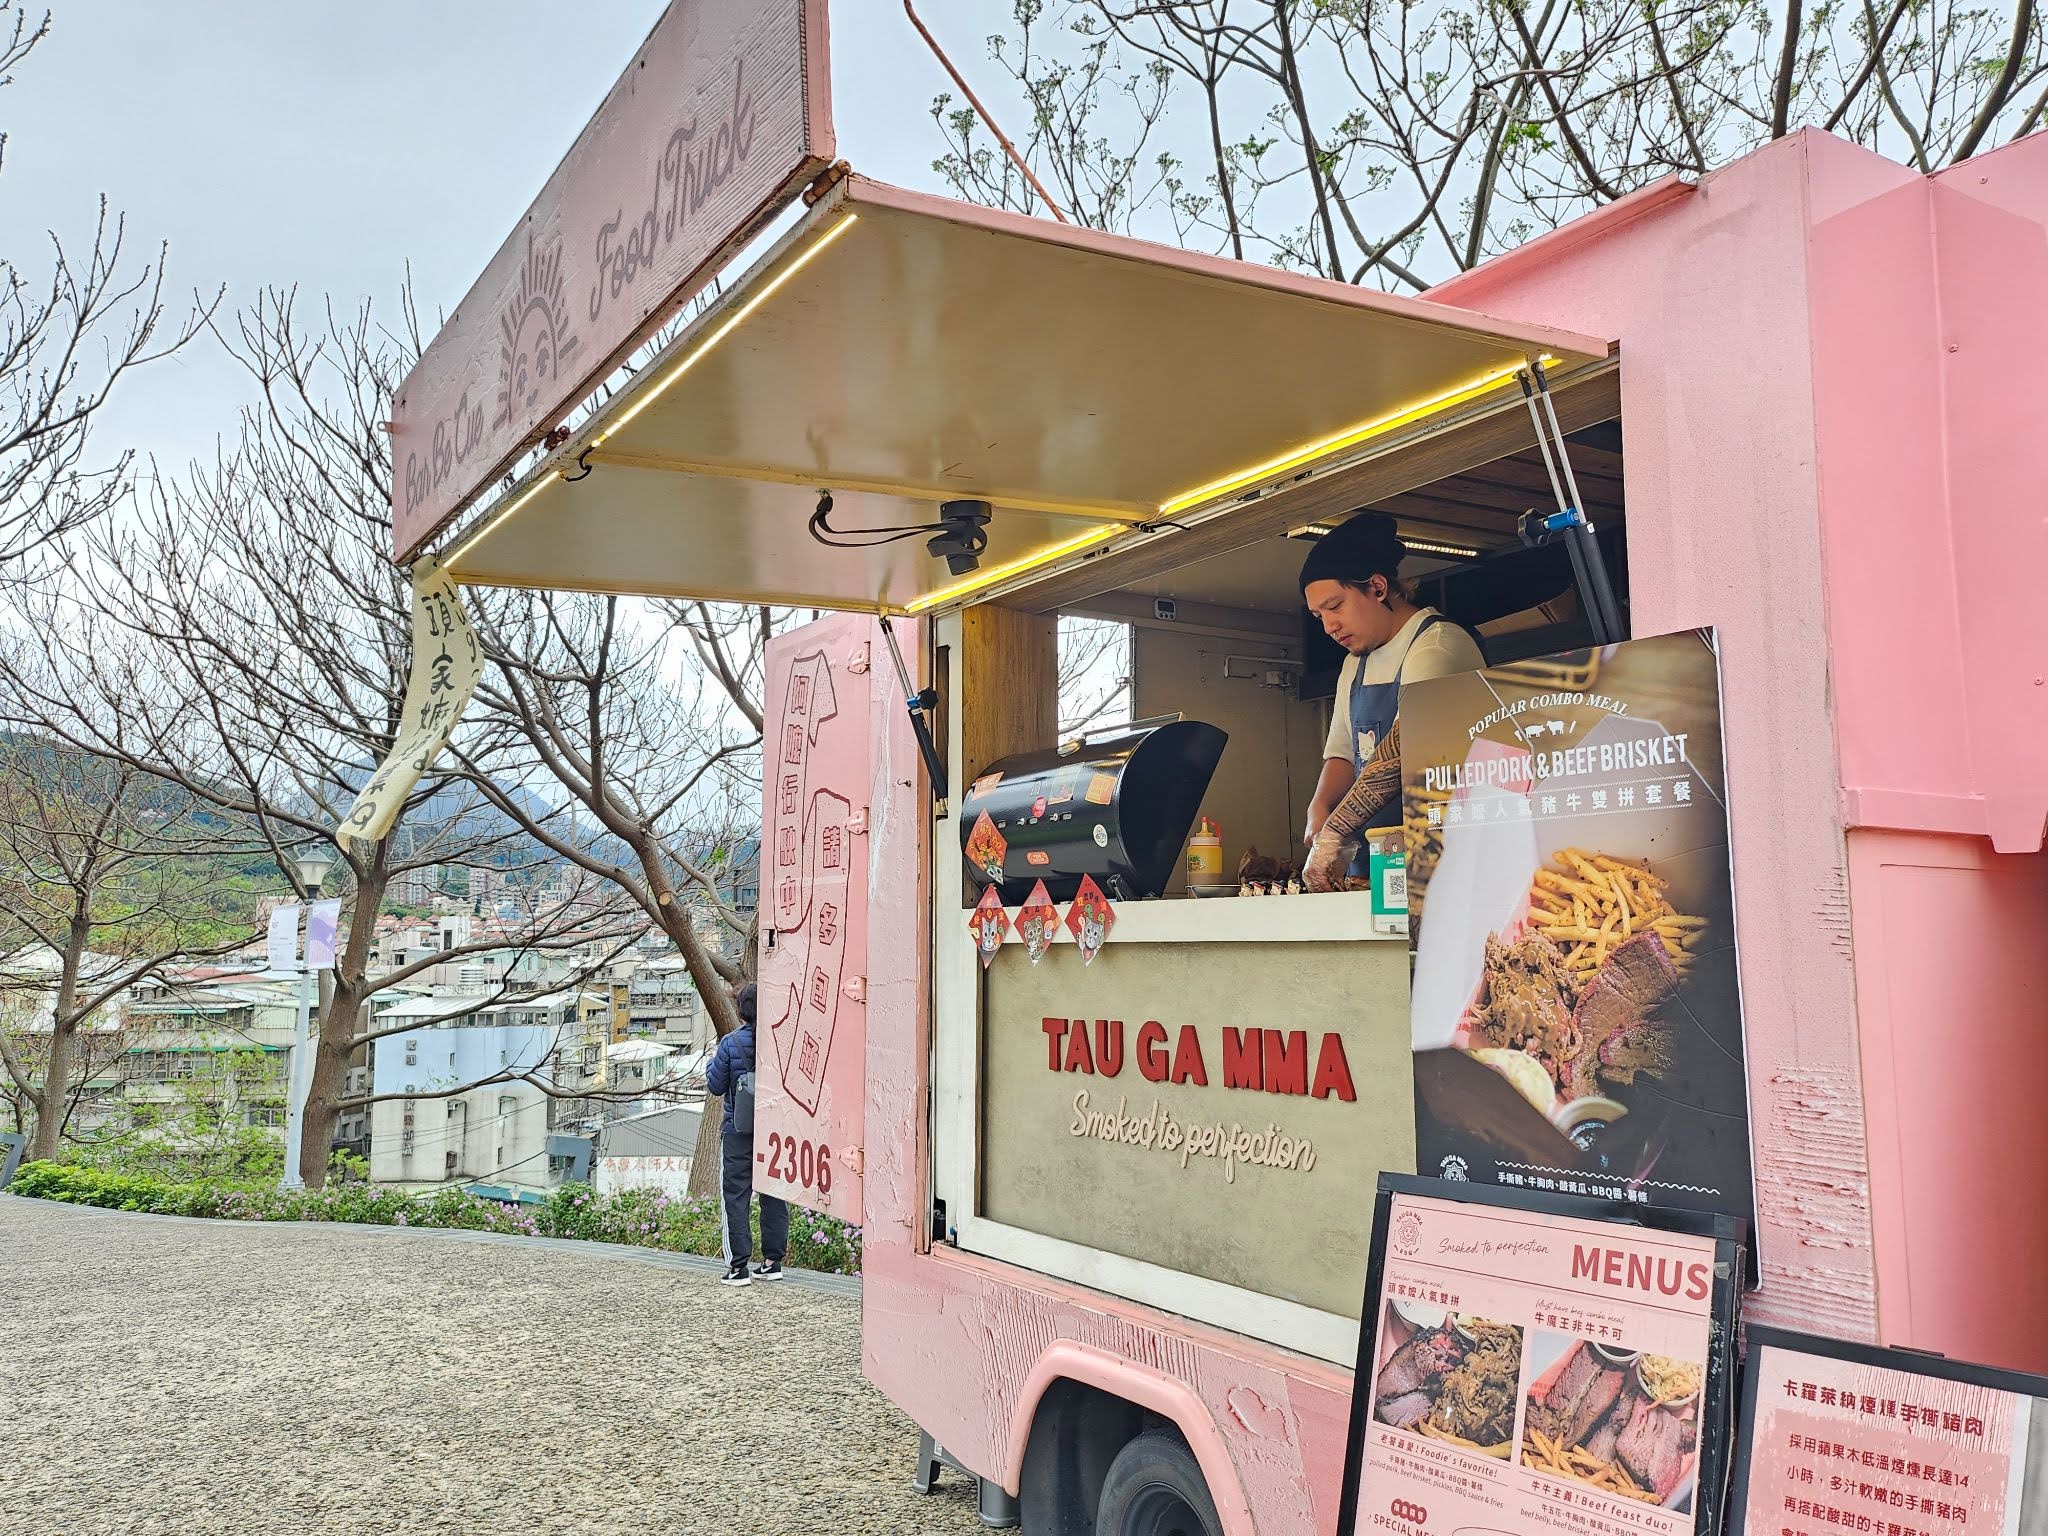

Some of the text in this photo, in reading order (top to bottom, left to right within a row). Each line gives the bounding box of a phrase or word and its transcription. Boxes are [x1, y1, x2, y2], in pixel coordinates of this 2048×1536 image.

[590, 160, 661, 322] Food
[664, 59, 755, 243] Truck
[1468, 692, 1629, 741] POPULAR COMBO MEAL
[1536, 752, 1550, 780] &
[1552, 746, 1598, 777] BEEF
[1600, 734, 1688, 772] BRISKET
[1042, 1017, 1357, 1102] TAU GA MMA
[1070, 1089, 1317, 1184] Smoked to perfection
[1437, 1237, 1551, 1257] Smoked to perfection
[1571, 1244, 1709, 1300] MENUS
[1534, 1311, 1622, 1341] 牛魔王非牛不可
[1783, 1378, 1984, 1438] 卡羅萊納煙燻手撕豬肉
[1459, 1458, 1498, 1478] favorite!
[1373, 1513, 1412, 1536] SPECIAL
[1581, 1496, 1608, 1512] Beef
[1611, 1504, 1641, 1523] feast
[1645, 1516, 1674, 1532] duo!
